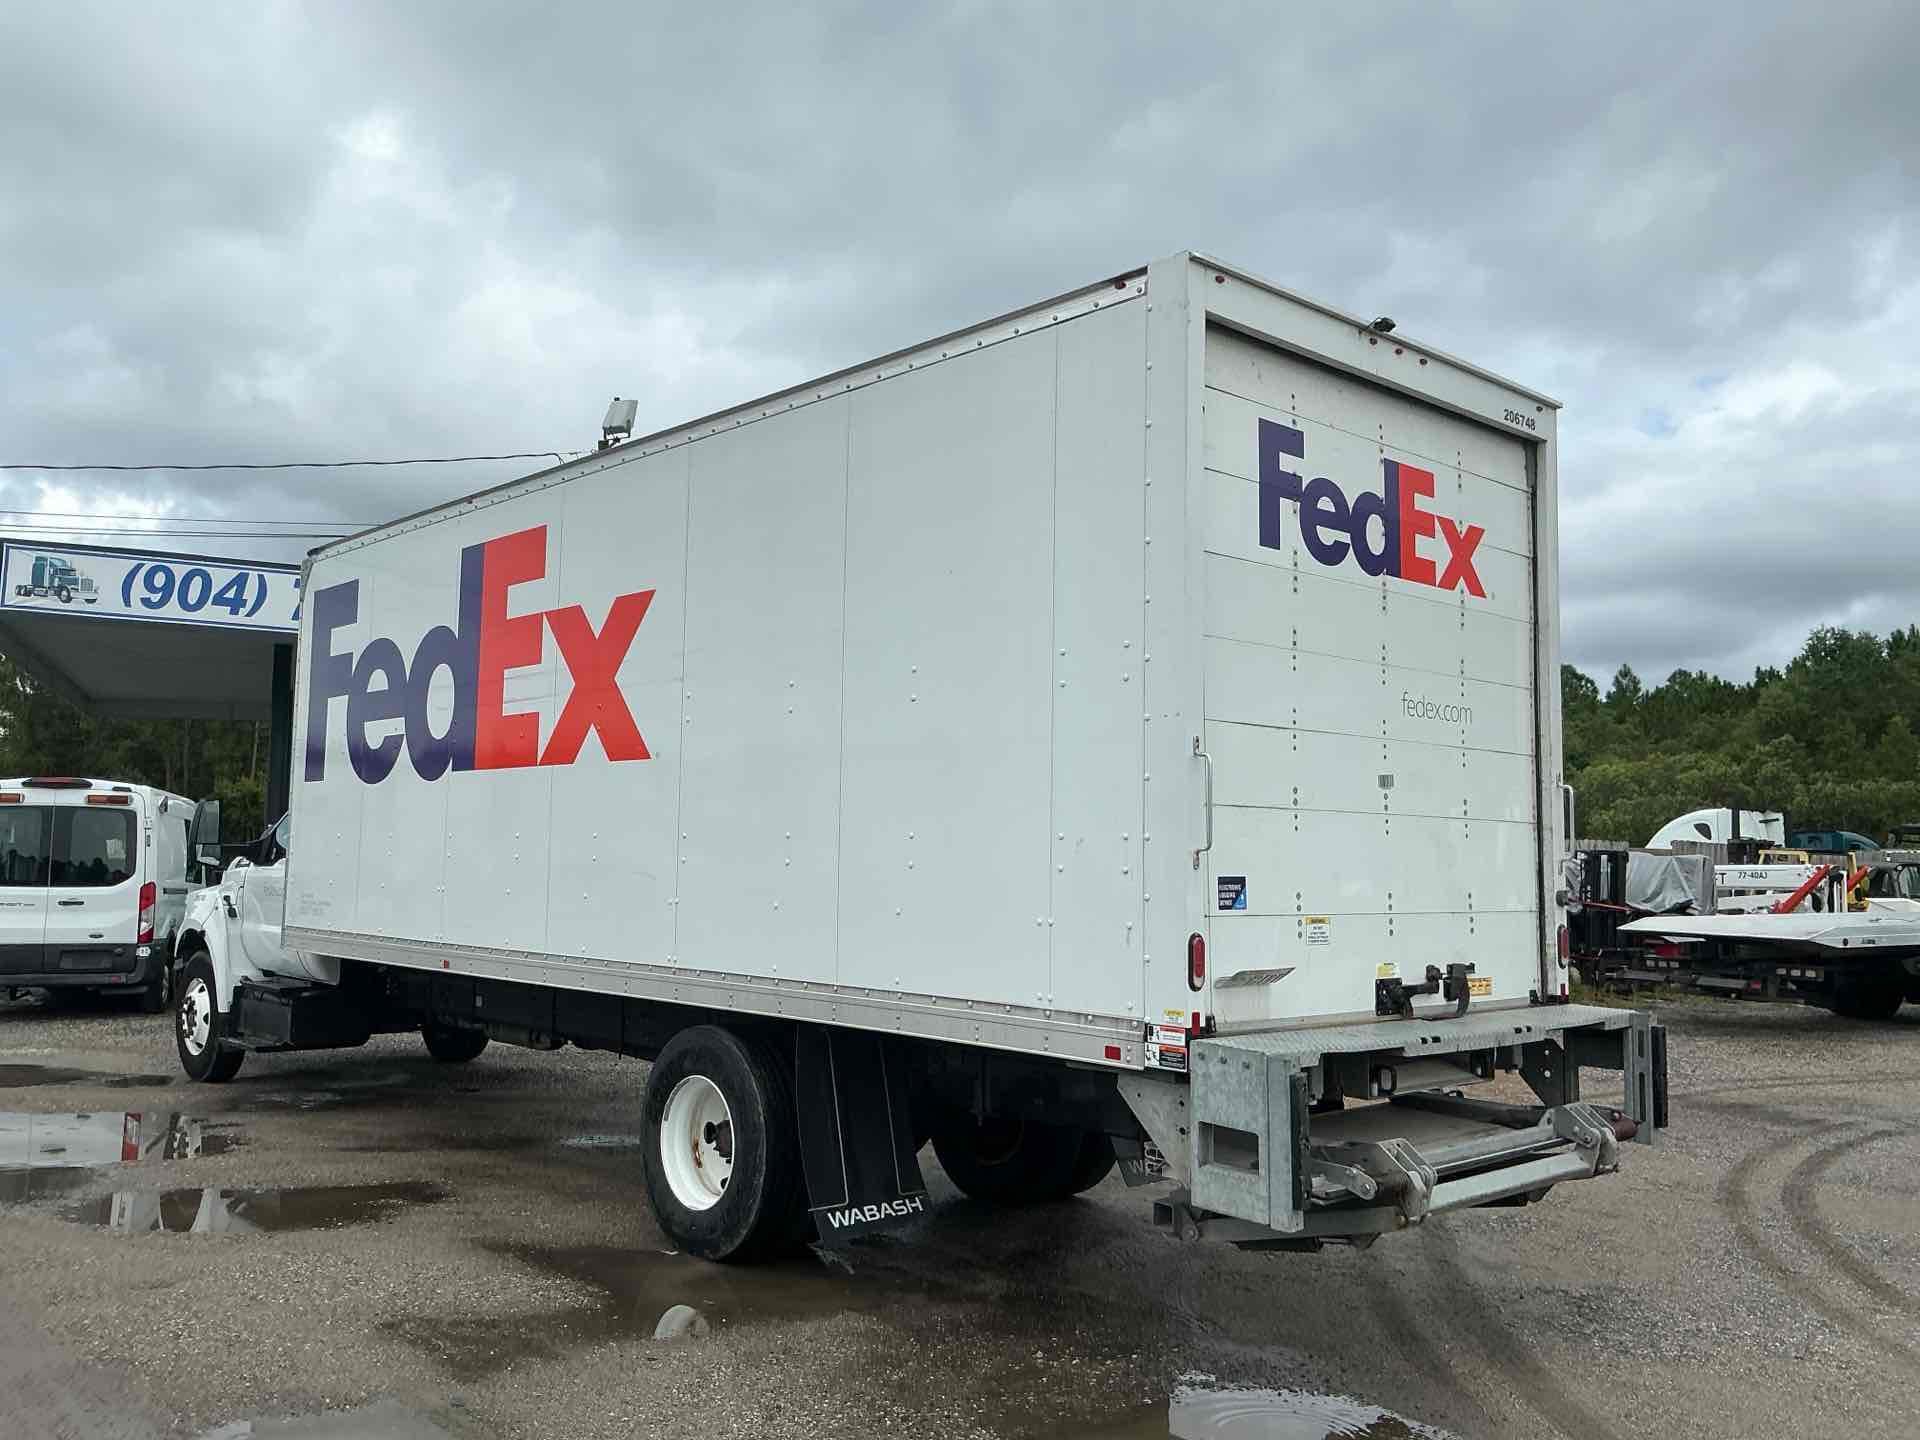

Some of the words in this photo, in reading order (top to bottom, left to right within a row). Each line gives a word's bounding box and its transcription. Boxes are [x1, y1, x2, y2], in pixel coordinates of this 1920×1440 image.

[1503, 408, 1536, 431] 206748
[1258, 416, 1488, 599] FedEx
[121, 562, 268, 618] (904)
[304, 524, 657, 785] FedEx
[1400, 691, 1473, 725] fedex.com
[827, 1197, 925, 1229] WABASH
